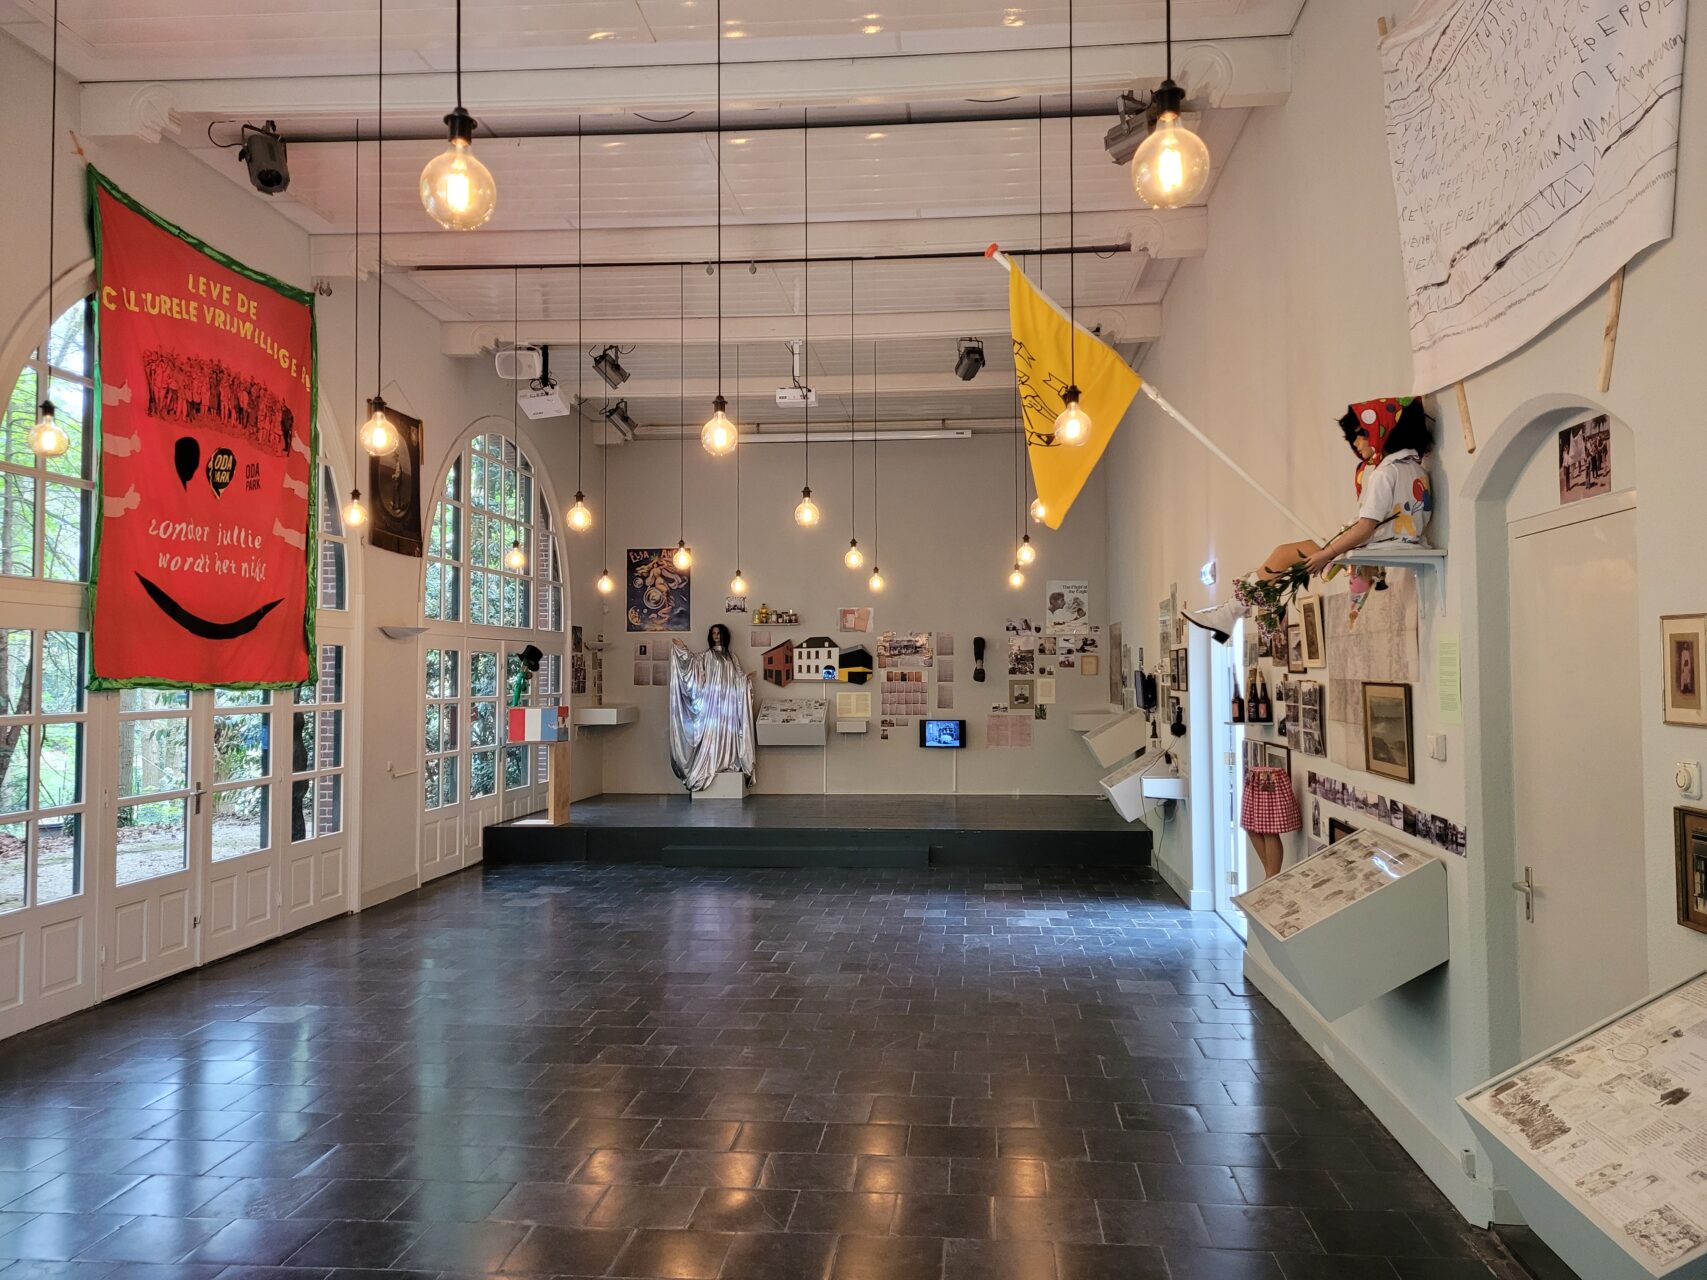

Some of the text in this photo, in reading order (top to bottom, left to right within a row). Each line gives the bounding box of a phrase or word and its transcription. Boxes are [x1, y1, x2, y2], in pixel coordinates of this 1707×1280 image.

[187, 273, 258, 320] LEVE DE
[214, 454, 233, 471] ODA
[245, 463, 261, 479] ODA
[213, 470, 232, 484] ARK
[148, 518, 262, 549] zonder jullie
[158, 551, 209, 573] wordt
[215, 552, 237, 575] het
[629, 550, 650, 563] ELSA
